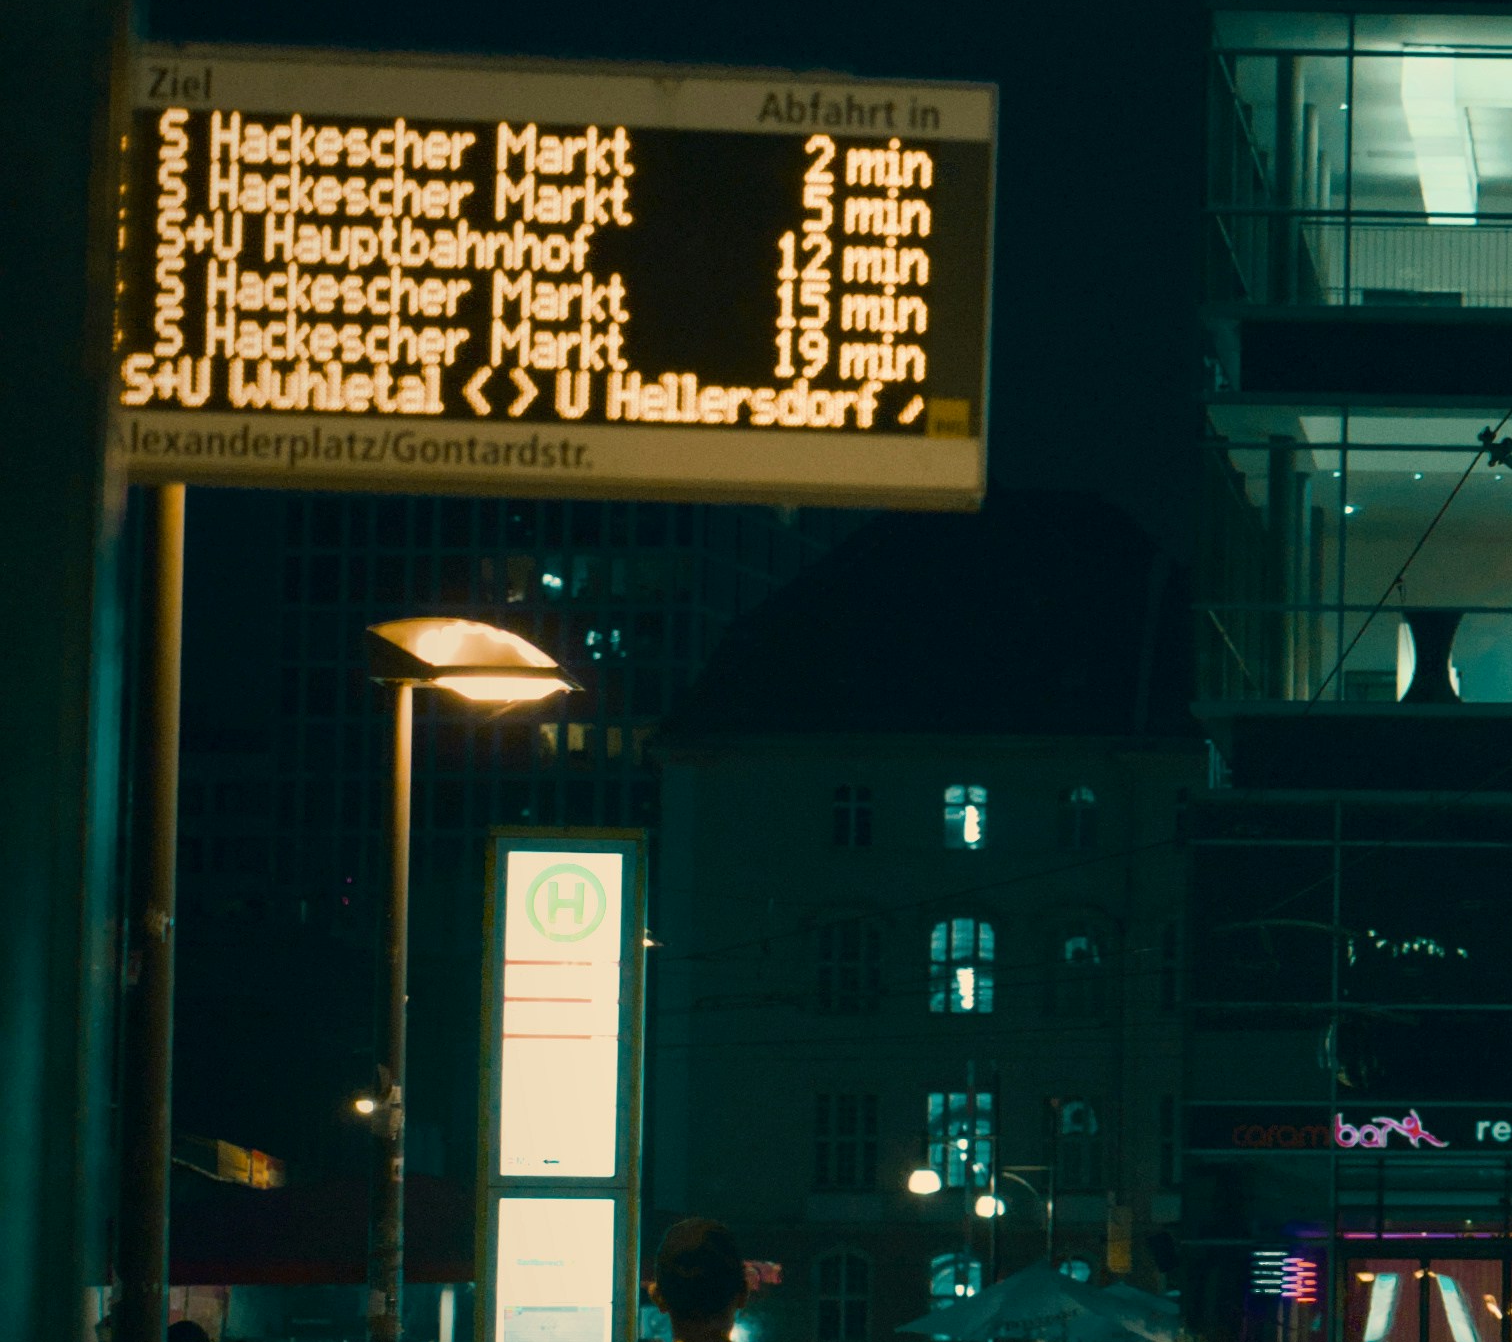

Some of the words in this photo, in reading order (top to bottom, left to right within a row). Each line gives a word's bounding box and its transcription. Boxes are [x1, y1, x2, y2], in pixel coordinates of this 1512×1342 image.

[148, 65, 213, 99] Ziel
[758, 91, 898, 127] Abfahrt
[908, 97, 940, 129] in
[158, 108, 190, 160] S
[209, 110, 476, 171] Hackescher
[496, 120, 635, 177] Markt
[804, 133, 836, 185] 2
[845, 136, 933, 189] min
[157, 158, 189, 211] S
[208, 159, 475, 220] Hackescher
[494, 170, 634, 227] Markt
[802, 183, 834, 234] 5
[843, 186, 931, 238] min
[155, 208, 243, 265] S+U
[264, 210, 595, 274] Hauptbahnhof
[778, 230, 833, 282] 12
[842, 235, 930, 287] min
[155, 259, 185, 309] S
[206, 258, 471, 317] Hackescher
[491, 269, 631, 324] Markt
[776, 279, 831, 330] 15
[841, 283, 928, 335] min
[153, 305, 184, 358] S
[205, 307, 470, 367] Hackescher
[490, 317, 629, 373] Markt
[774, 328, 829, 379] 19
[839, 332, 927, 384] min
[119, 352, 212, 408] S+U
[227, 358, 446, 416] Wuhletal
[554, 368, 590, 420] U
[605, 370, 883, 430] Hellersdorf
